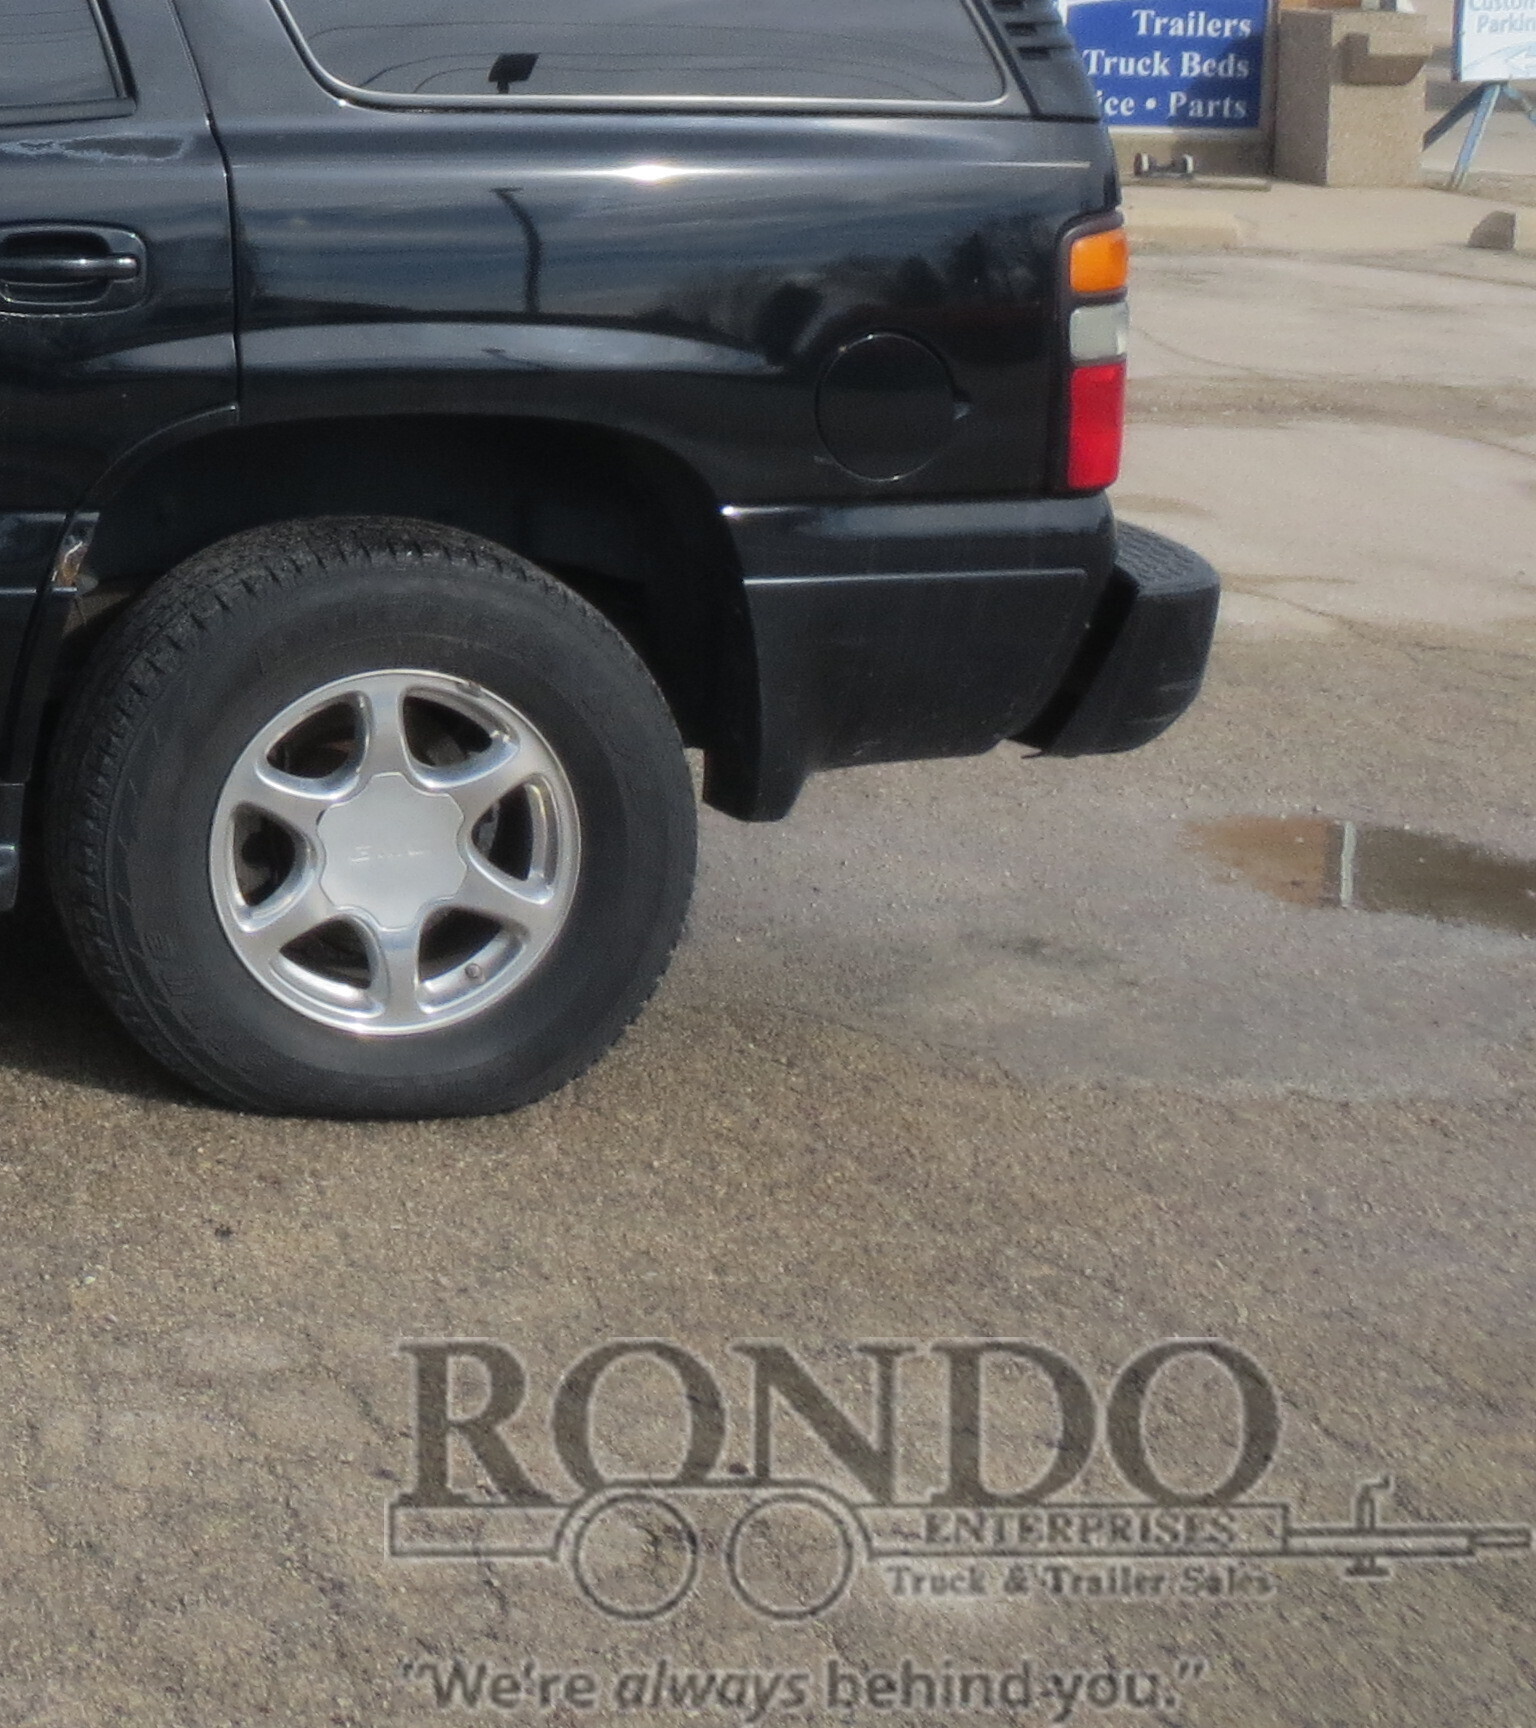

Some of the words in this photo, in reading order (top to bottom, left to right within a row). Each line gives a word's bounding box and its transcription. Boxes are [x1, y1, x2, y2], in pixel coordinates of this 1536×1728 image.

[1131, 9, 1252, 38] Trailers
[1081, 48, 1171, 77] Truck
[1179, 50, 1250, 79] Beds
[1167, 90, 1248, 119] Parts
